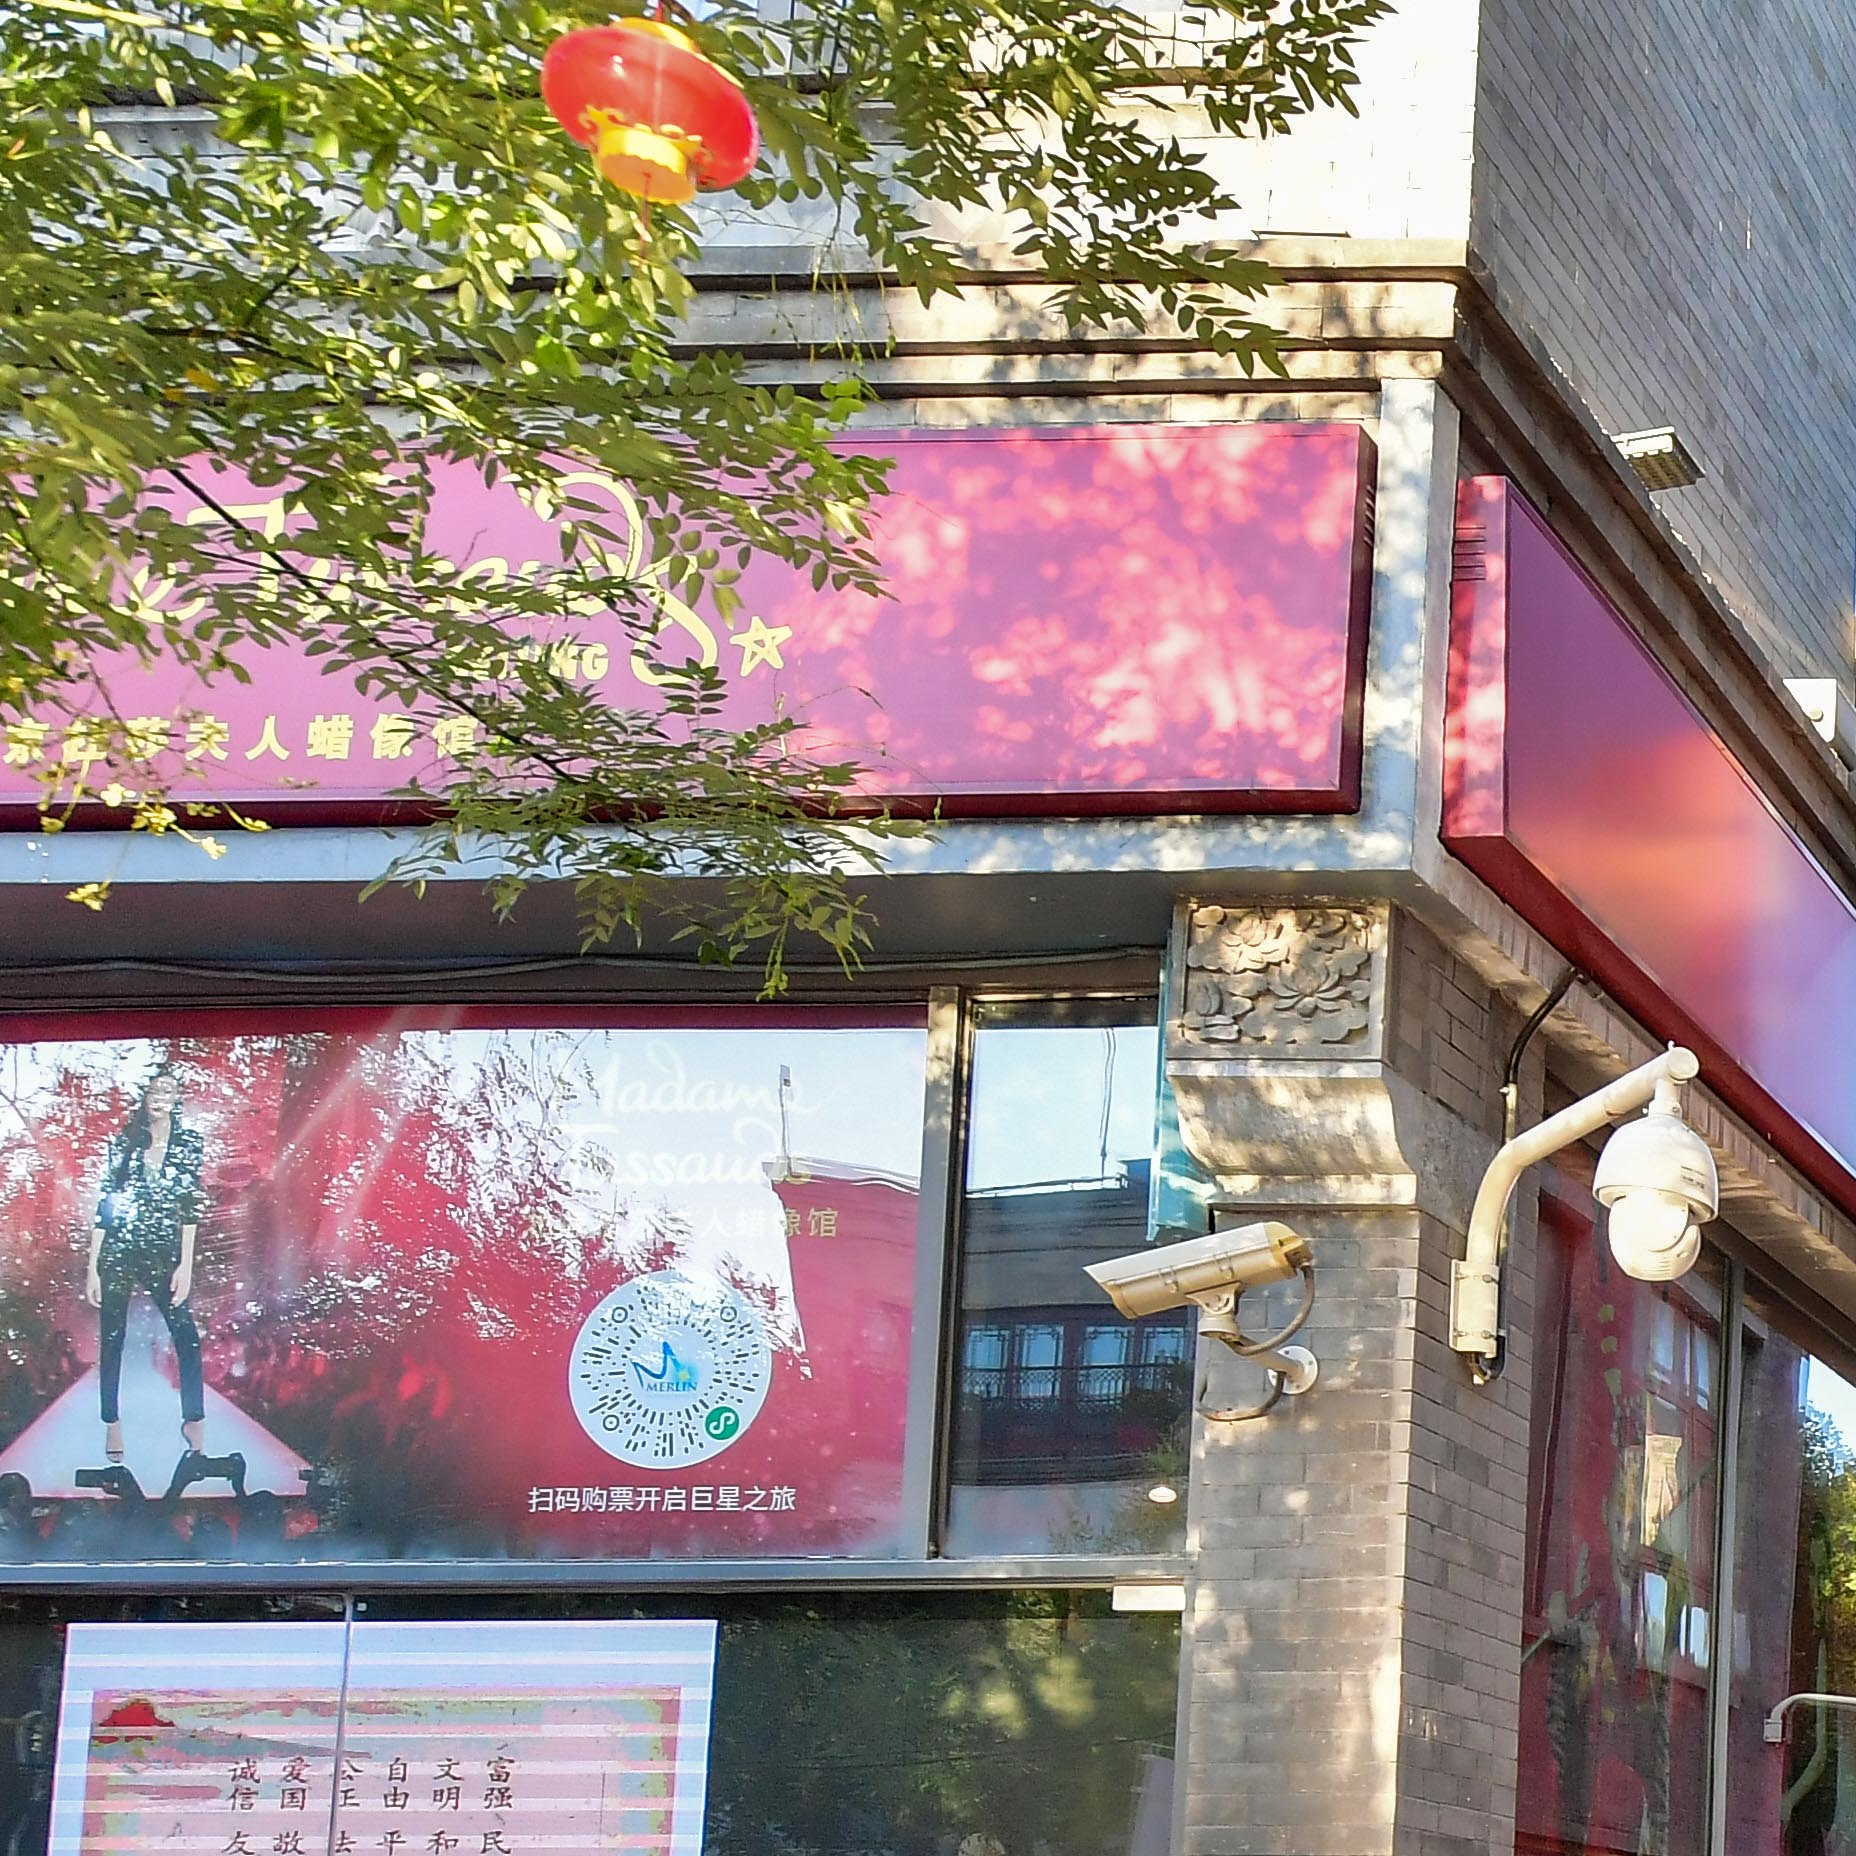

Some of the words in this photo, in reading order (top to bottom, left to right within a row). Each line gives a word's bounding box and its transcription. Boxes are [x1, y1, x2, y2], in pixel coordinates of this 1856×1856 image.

[646, 1381, 698, 1393] MERLIN
[528, 1486, 797, 1514] 扫码购票开启巨星之旅
